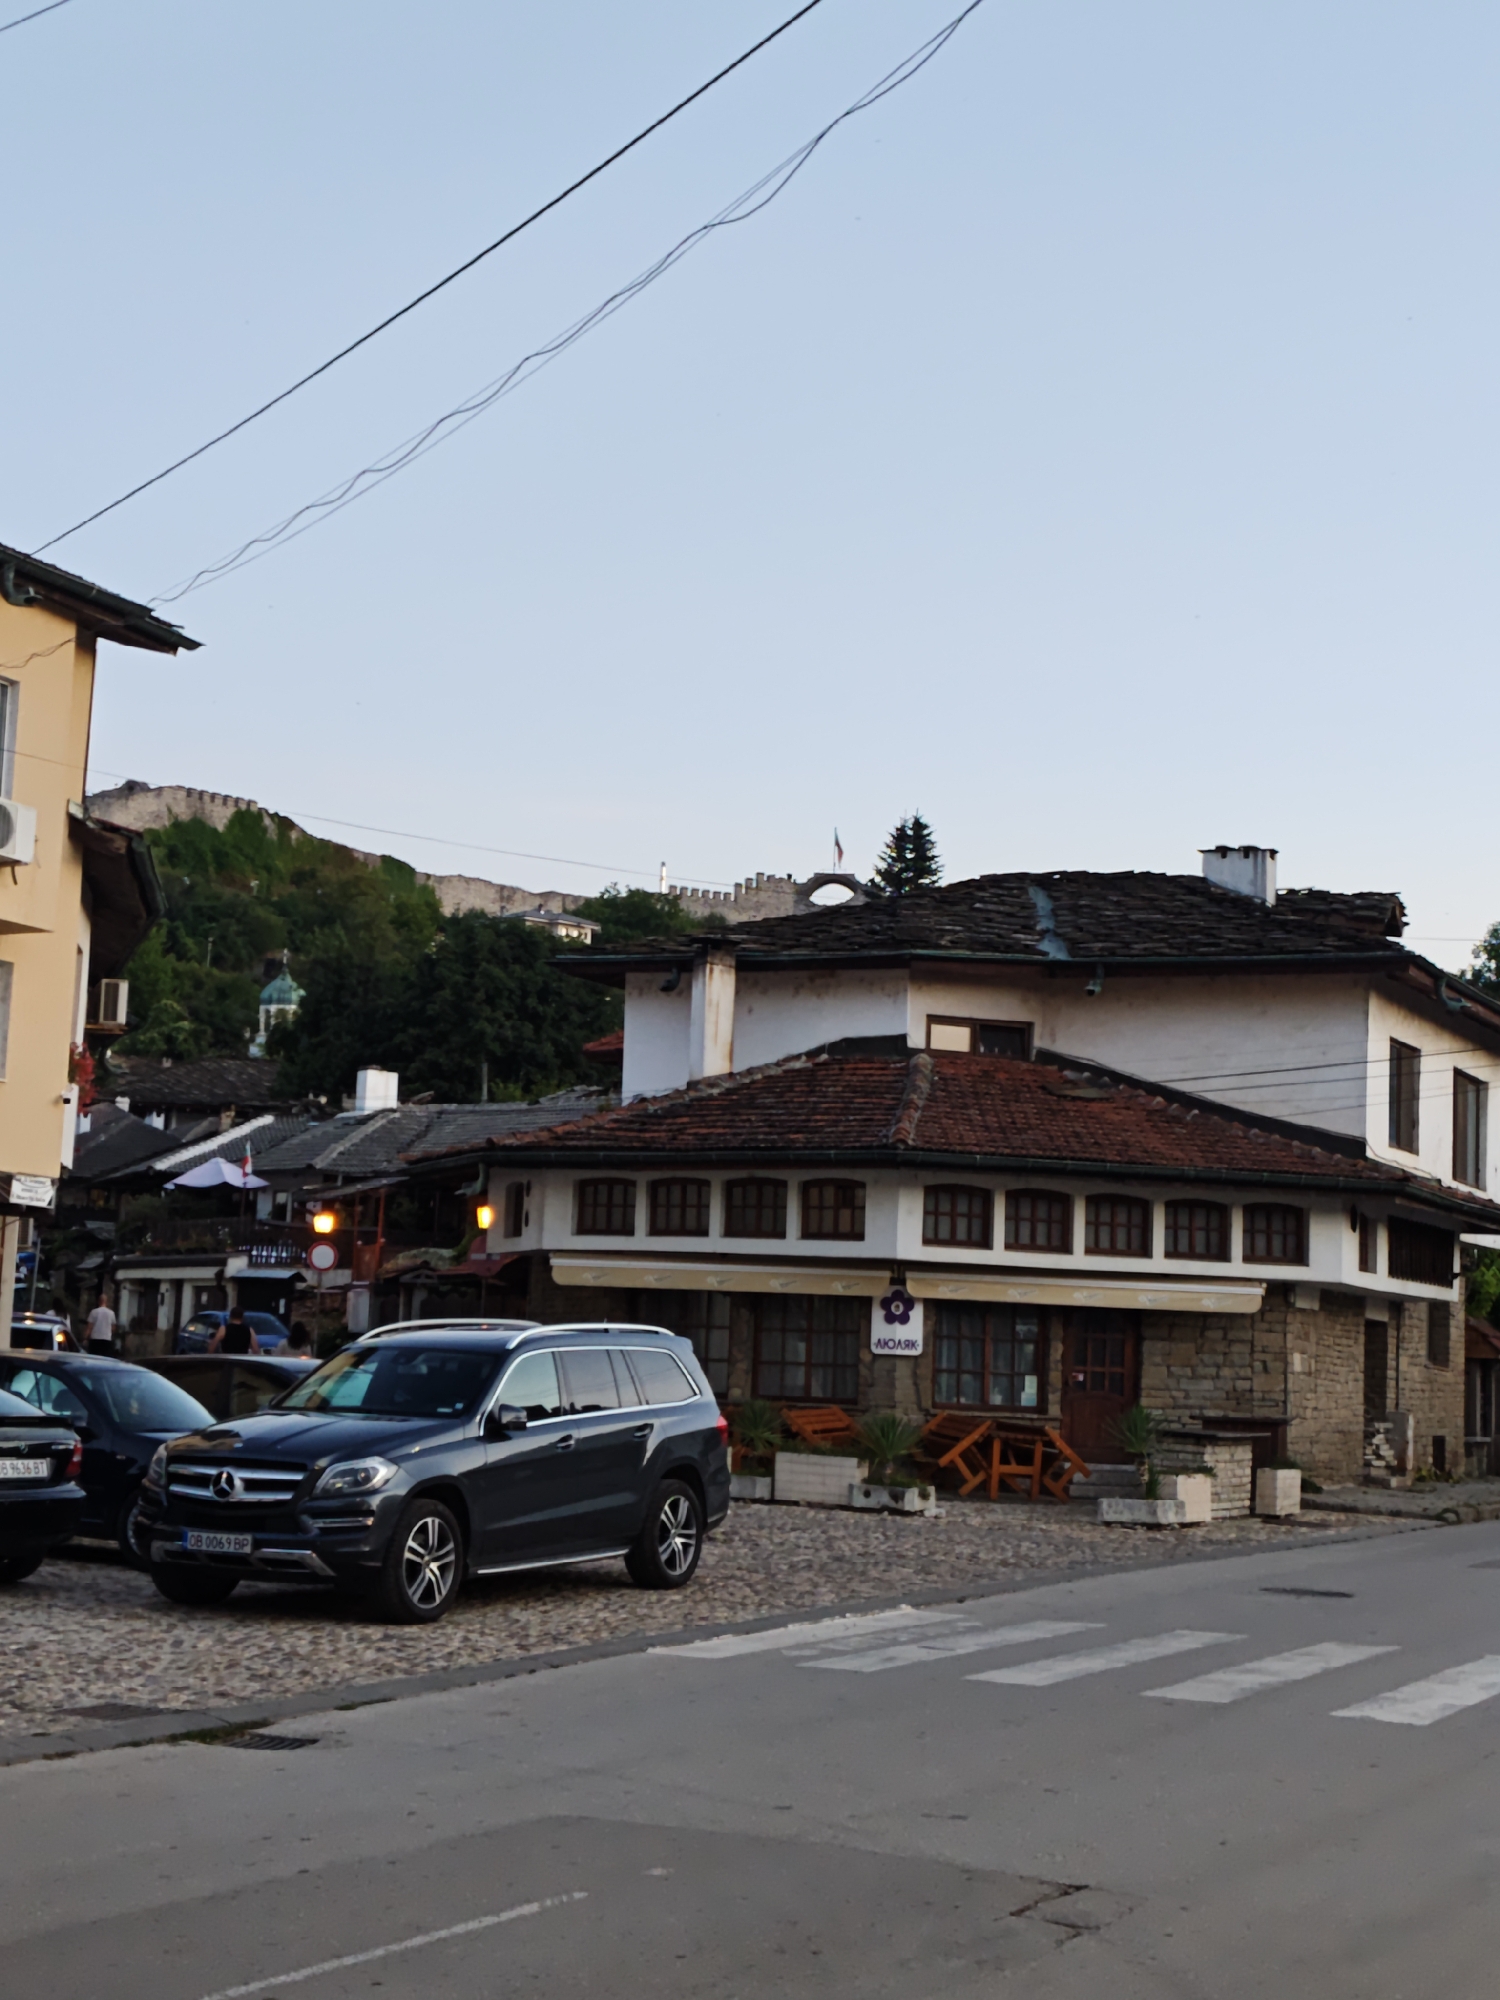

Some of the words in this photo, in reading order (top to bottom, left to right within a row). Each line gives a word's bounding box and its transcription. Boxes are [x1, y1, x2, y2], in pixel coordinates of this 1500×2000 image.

[9, 1462, 32, 1475] 9636
[205, 1535, 232, 1549] 0069
[234, 1537, 249, 1551] BP
